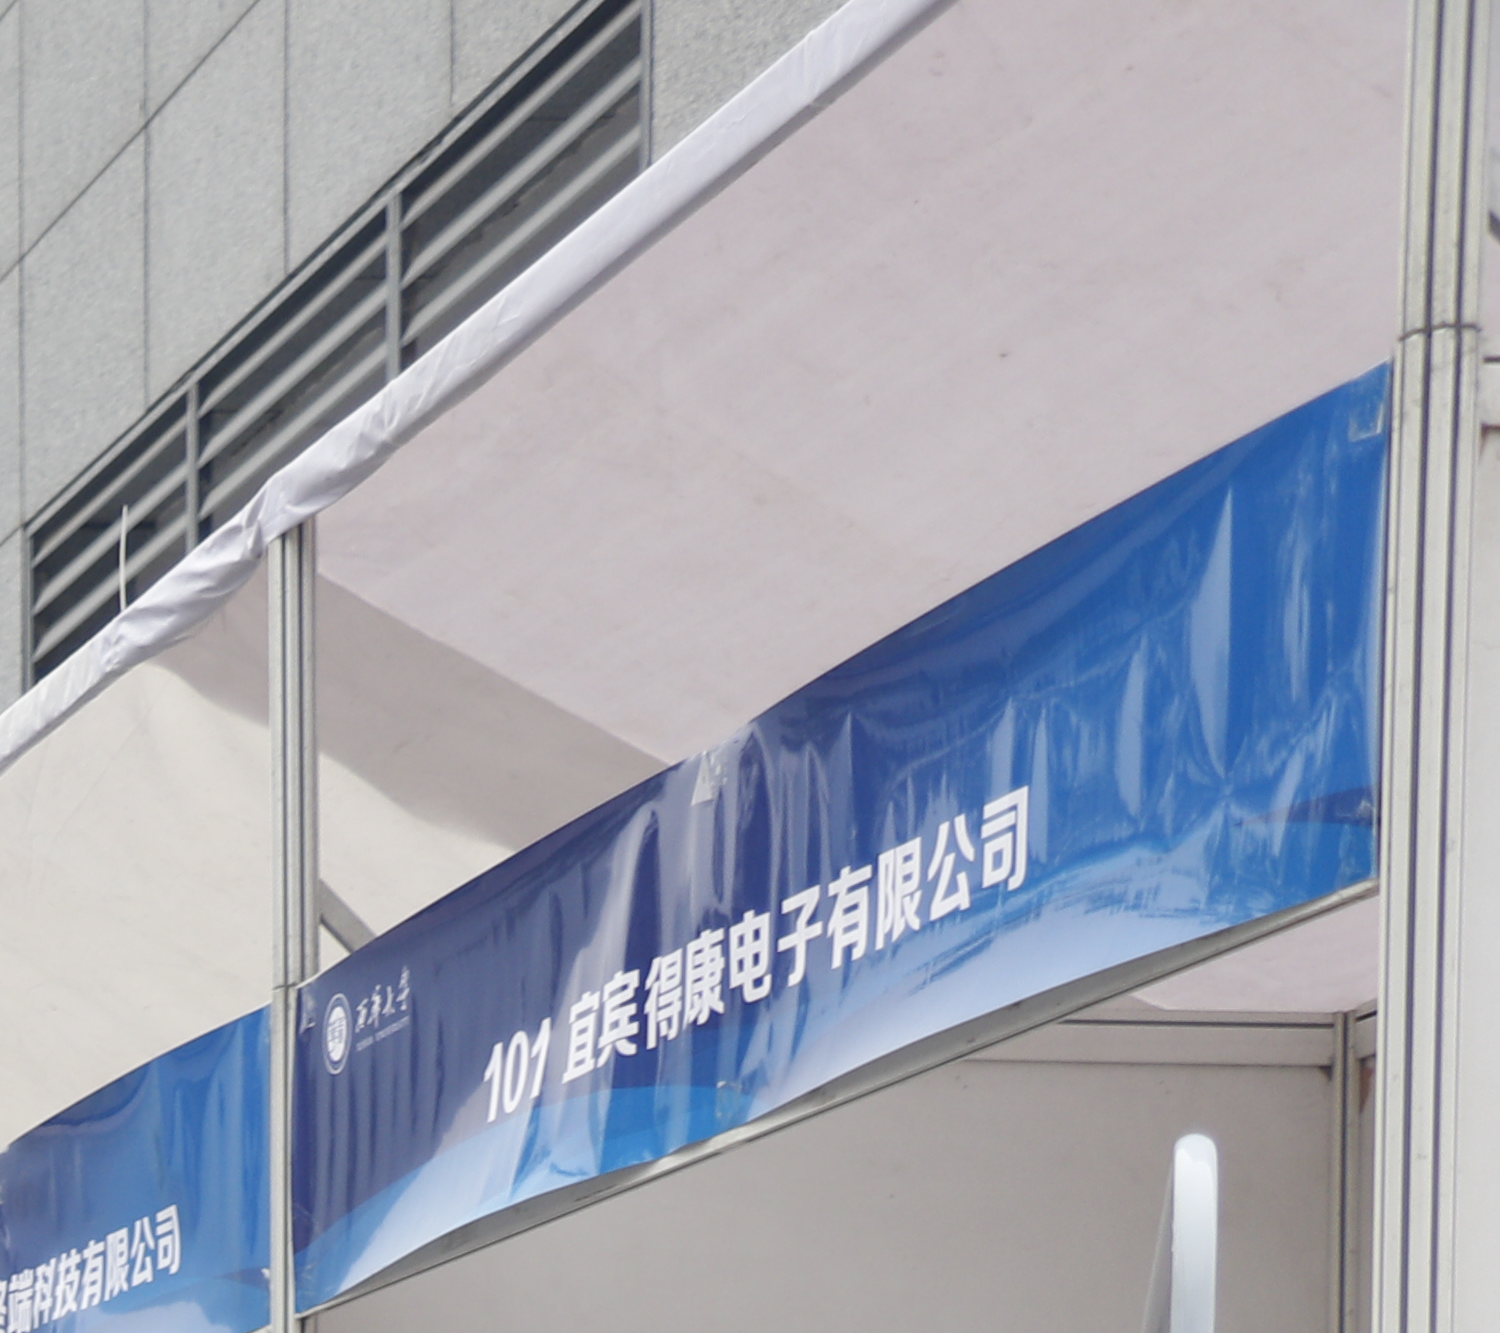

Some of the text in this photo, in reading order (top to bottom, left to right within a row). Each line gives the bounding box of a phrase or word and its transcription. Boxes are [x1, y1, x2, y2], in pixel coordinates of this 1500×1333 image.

[481, 784, 1030, 1125] 101 宜宾得康电子有限公司
